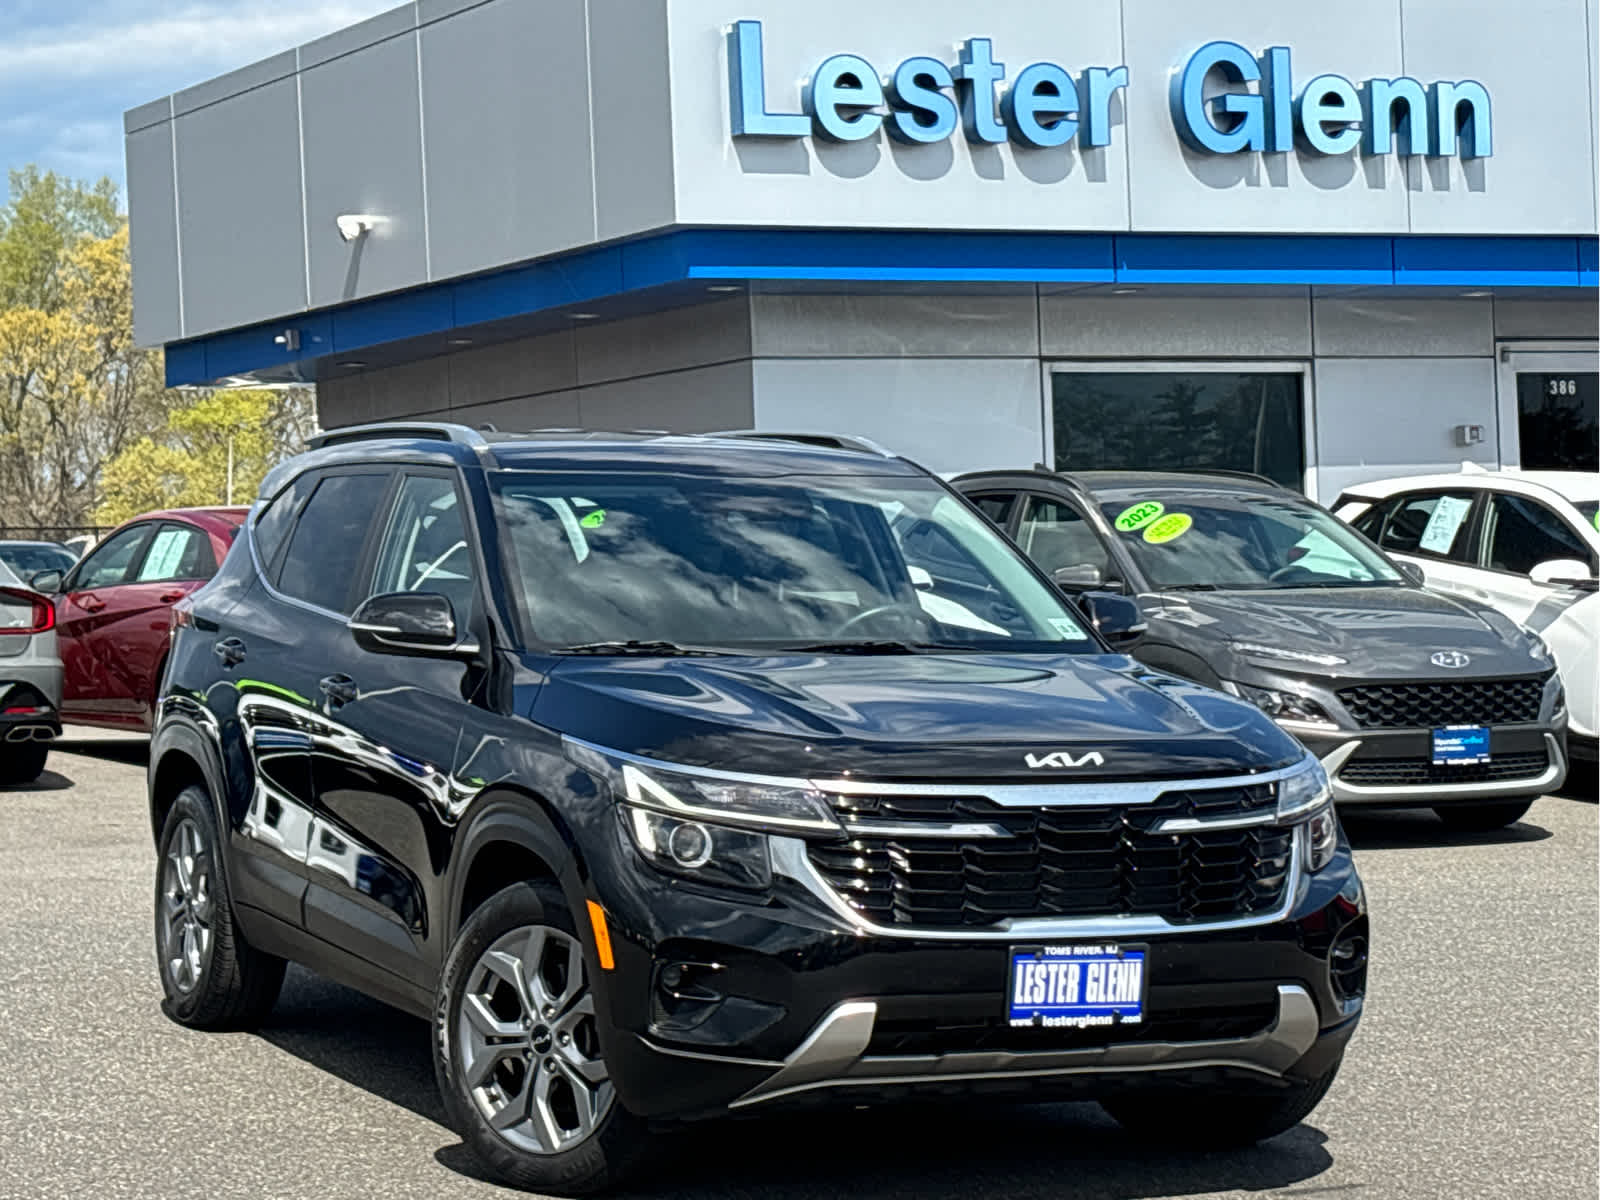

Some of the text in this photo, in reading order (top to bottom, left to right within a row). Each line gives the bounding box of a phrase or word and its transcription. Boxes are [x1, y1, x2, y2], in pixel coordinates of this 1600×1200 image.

[728, 20, 1493, 157] Lester Glenn
[1550, 380, 1576, 395] 386
[1121, 503, 1159, 528] 2023
[1044, 946, 1072, 956] TOMS
[1105, 945, 1118, 955] NJ
[1014, 962, 1142, 1004] LESTER GLENN
[1042, 1015, 1113, 1028] lesterglenn
